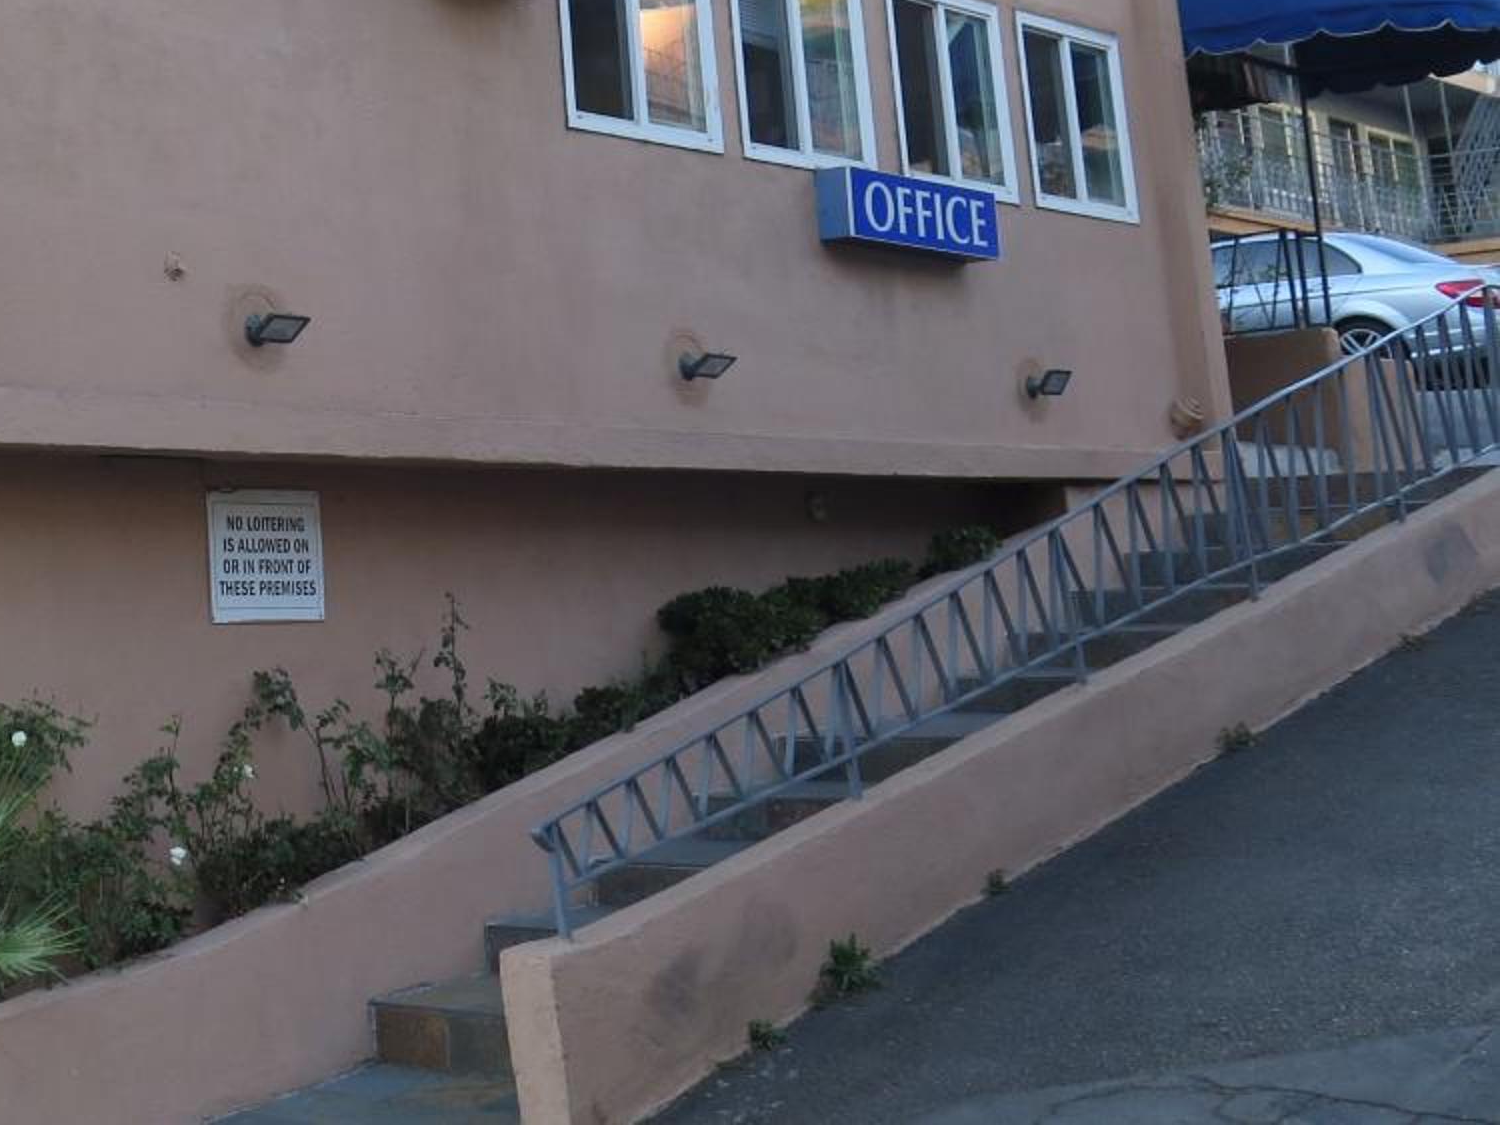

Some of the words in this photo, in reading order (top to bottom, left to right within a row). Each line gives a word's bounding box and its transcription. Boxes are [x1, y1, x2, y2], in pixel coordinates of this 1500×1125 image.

[864, 181, 989, 248] OFFICE
[226, 515, 243, 532] NO
[247, 516, 305, 532] LOITERING
[223, 538, 235, 553] IS
[238, 538, 291, 554] ALLOWED
[294, 538, 309, 553] ON
[223, 559, 239, 574] OR
[243, 559, 255, 574] IN
[259, 559, 294, 574] FRONT
[297, 559, 312, 574] OF
[220, 580, 256, 596] THESE
[259, 580, 317, 596] PREMISES
